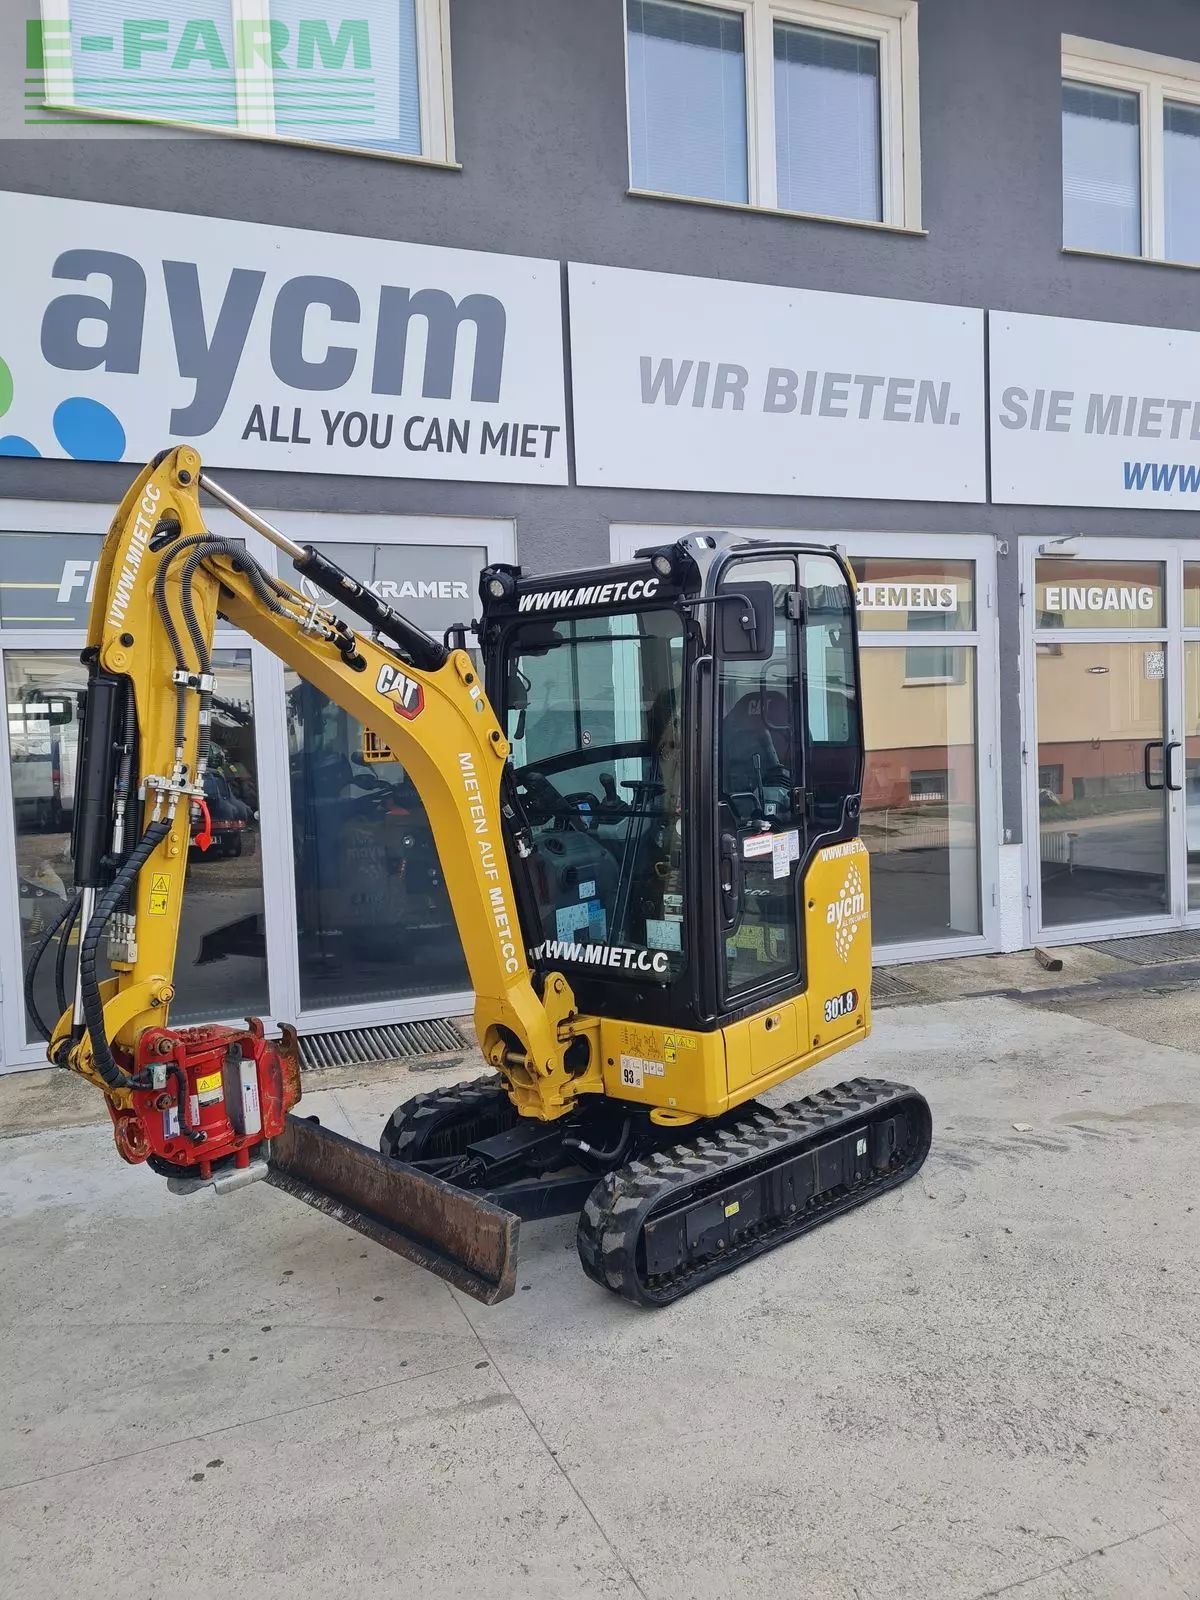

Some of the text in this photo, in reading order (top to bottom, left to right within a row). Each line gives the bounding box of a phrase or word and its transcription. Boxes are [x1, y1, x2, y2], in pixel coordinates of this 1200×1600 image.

[40, 249, 506, 436] aycm
[639, 356, 961, 425] WIR BIETEN.
[999, 386, 1074, 432] SIE
[241, 404, 561, 460] ALL YOU CAN MIET
[363, 580, 469, 599] KRAMER
[518, 578, 660, 612] WWW.MIET.CC
[856, 587, 953, 607] LEMENS
[1046, 587, 1154, 611] EINGANG
[376, 663, 419, 709] CAT
[459, 752, 519, 973] MIETEN AUF MIET.CC
[827, 893, 865, 929] aycm
[530, 939, 669, 973] WW.MIET.CC
[825, 991, 853, 1022] 301.8
[623, 1068, 634, 1084] 93
